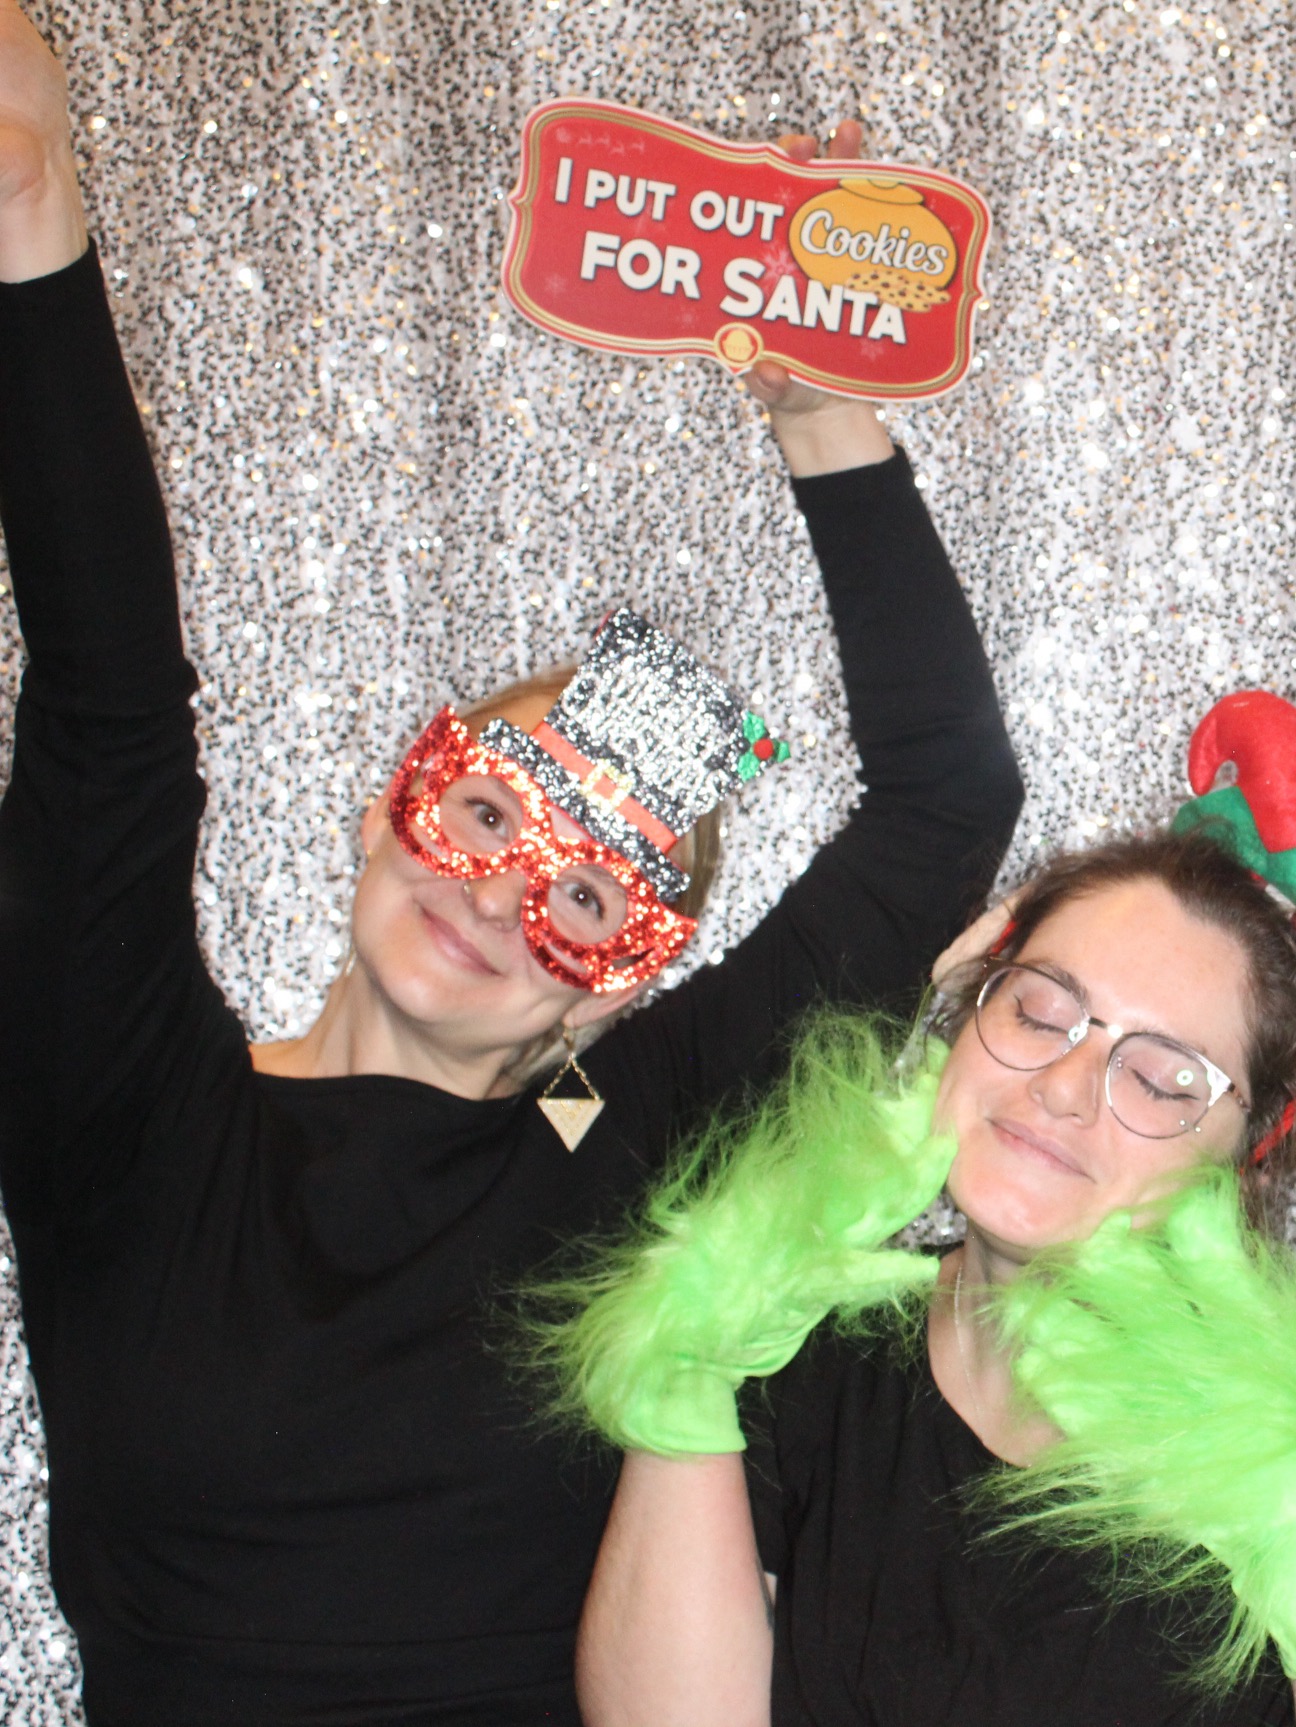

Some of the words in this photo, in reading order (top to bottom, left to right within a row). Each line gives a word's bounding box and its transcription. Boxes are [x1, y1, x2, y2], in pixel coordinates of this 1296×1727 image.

[554, 156, 573, 202] I
[583, 167, 676, 221] PUT
[690, 190, 785, 241] OUT
[799, 208, 950, 276] Cookies
[580, 230, 701, 299] FOR
[719, 257, 908, 345] SANTA
